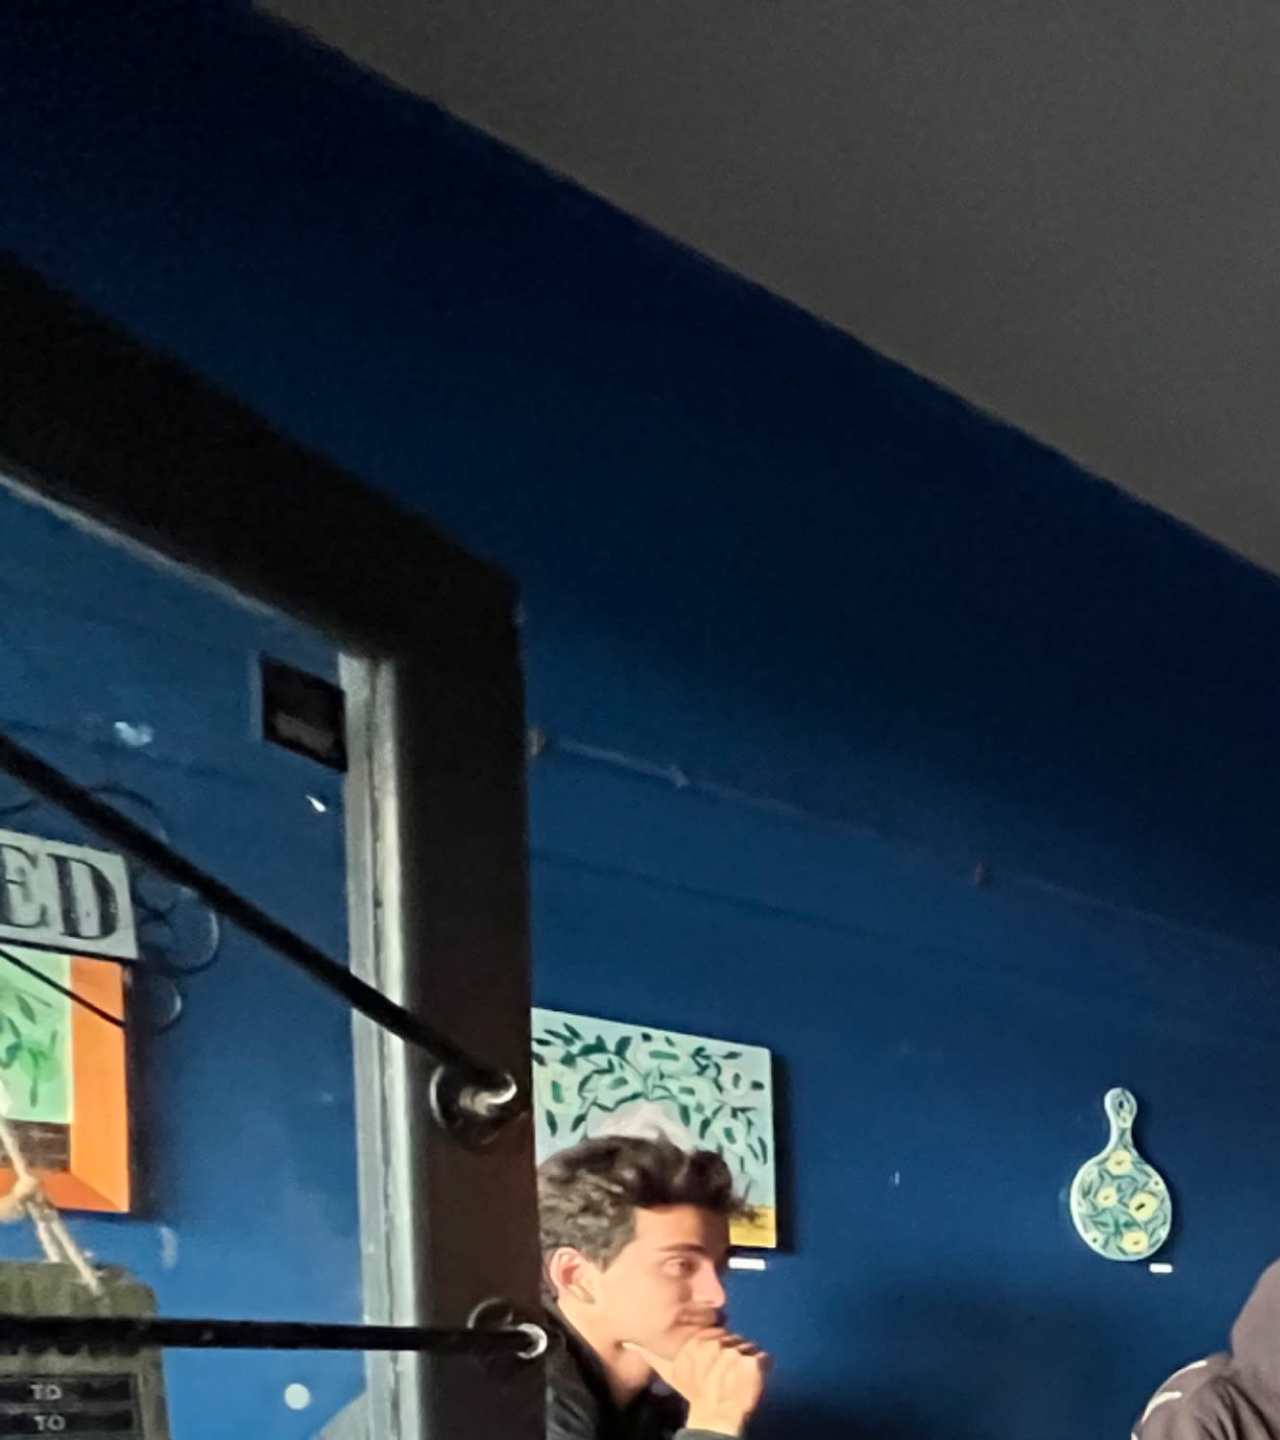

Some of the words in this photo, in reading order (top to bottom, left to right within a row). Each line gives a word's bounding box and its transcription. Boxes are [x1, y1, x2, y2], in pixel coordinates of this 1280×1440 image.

[0, 843, 118, 940] ED
[30, 1384, 62, 1400] TO
[33, 1414, 66, 1431] TO
